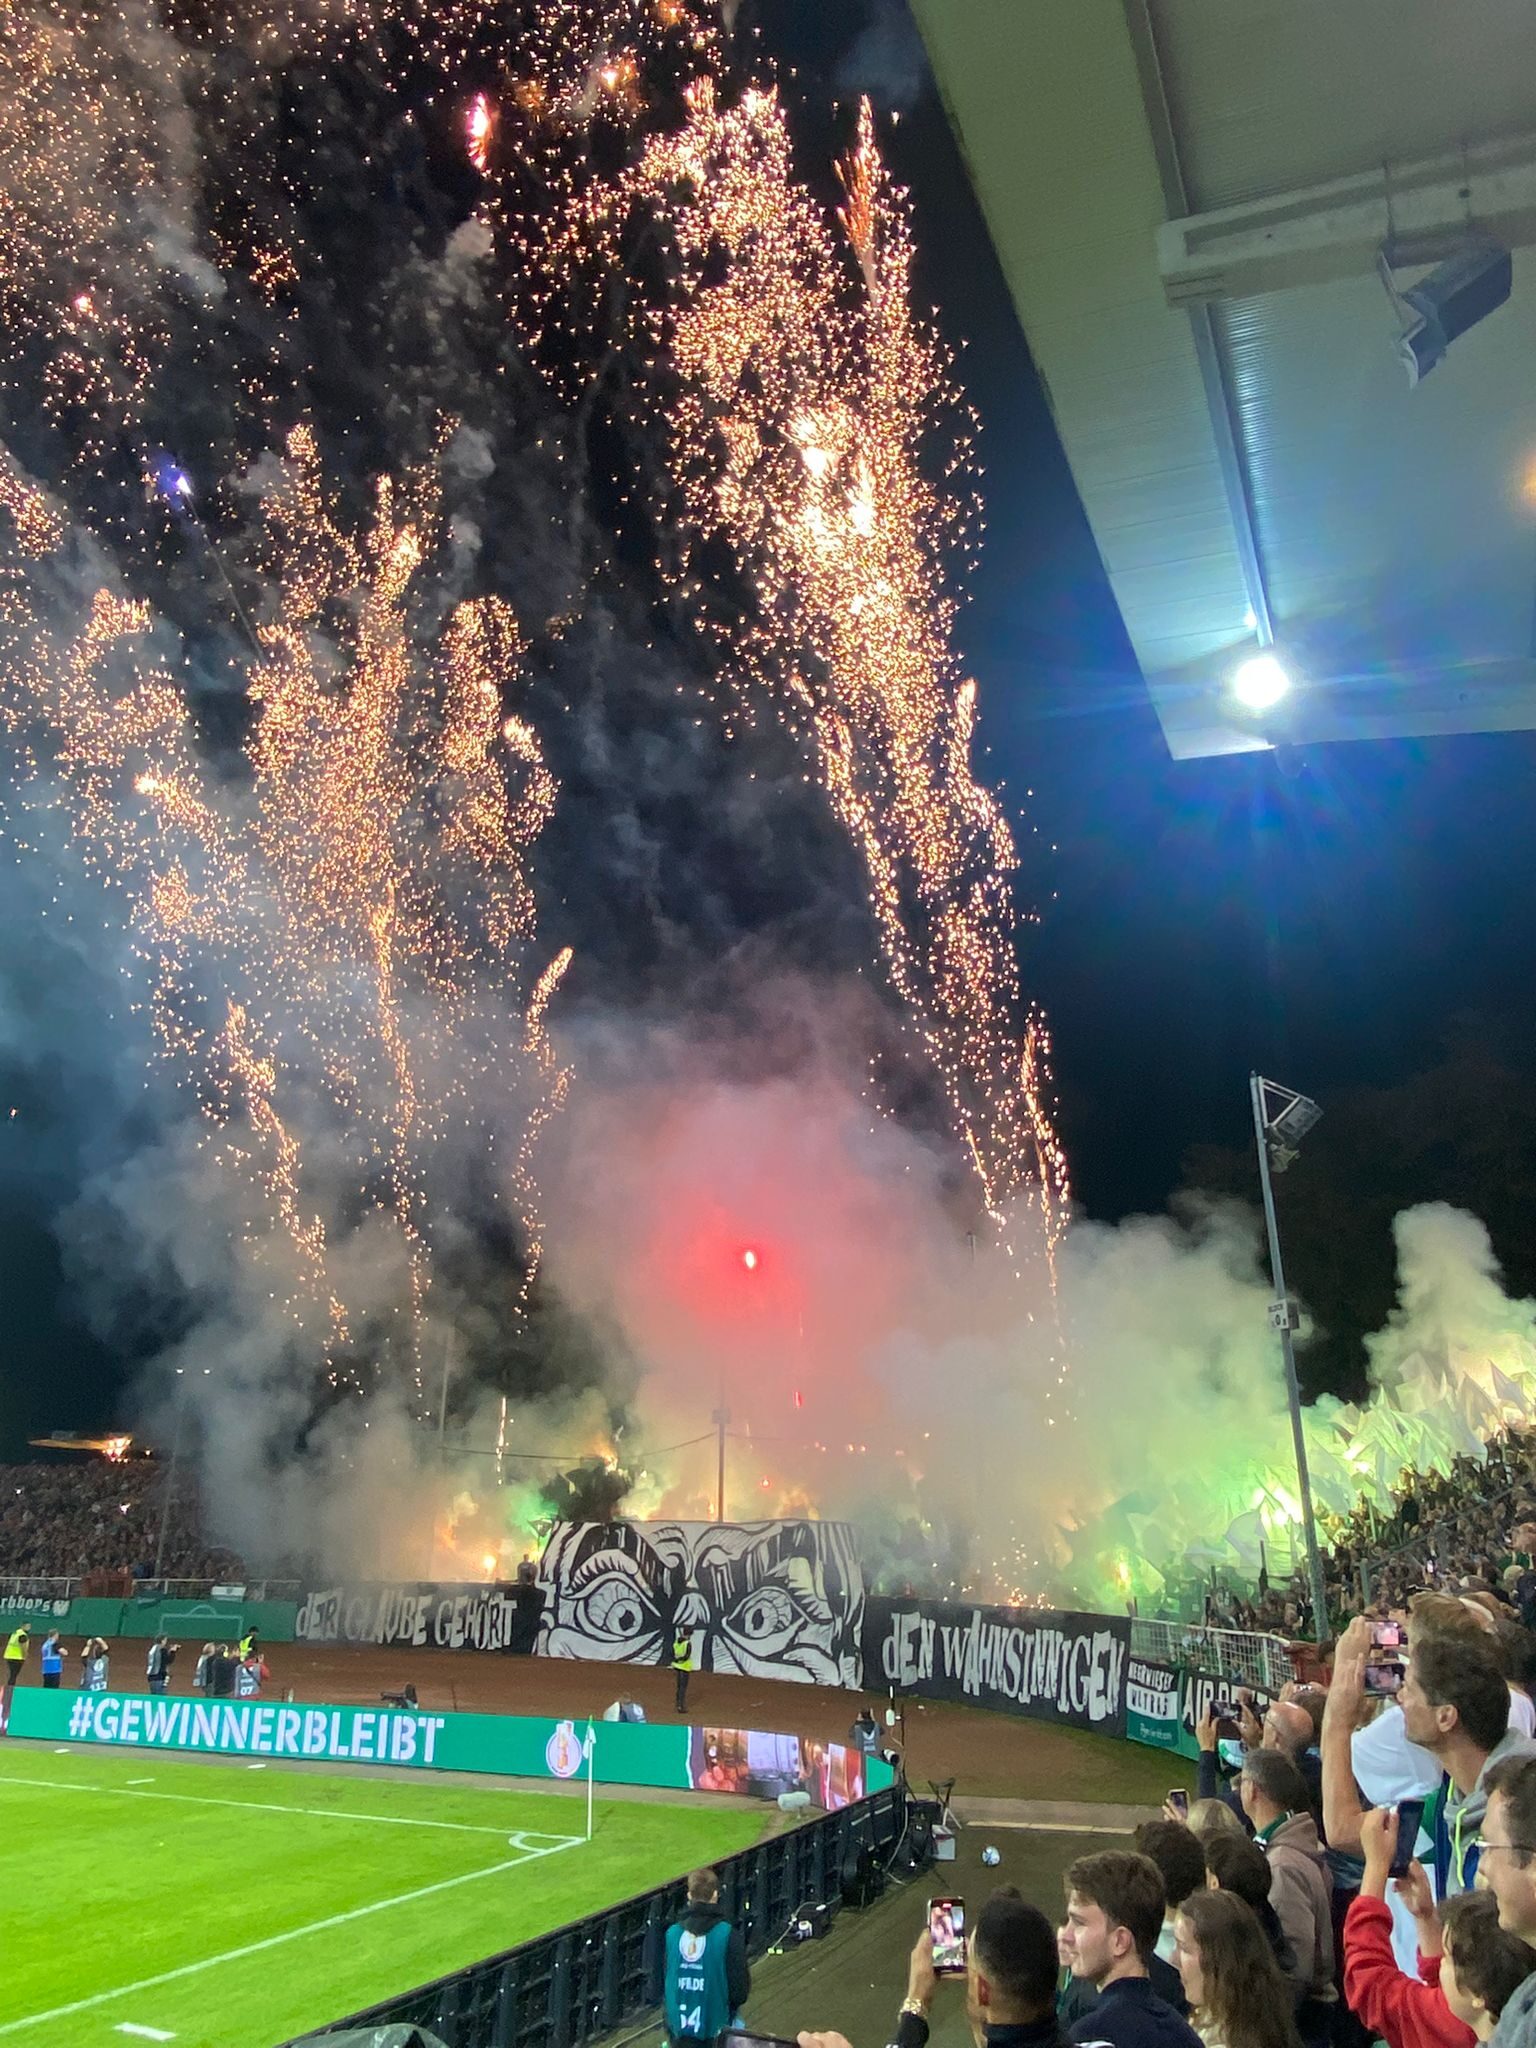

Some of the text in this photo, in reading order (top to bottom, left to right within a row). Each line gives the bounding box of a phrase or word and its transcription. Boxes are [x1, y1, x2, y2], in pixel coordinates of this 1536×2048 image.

[435, 1590, 518, 1650] GEHÖRT
[940, 1609, 1125, 1722] WAHNSINNIGEN
[68, 1695, 446, 1764] #GEWINNERBLEIBT
